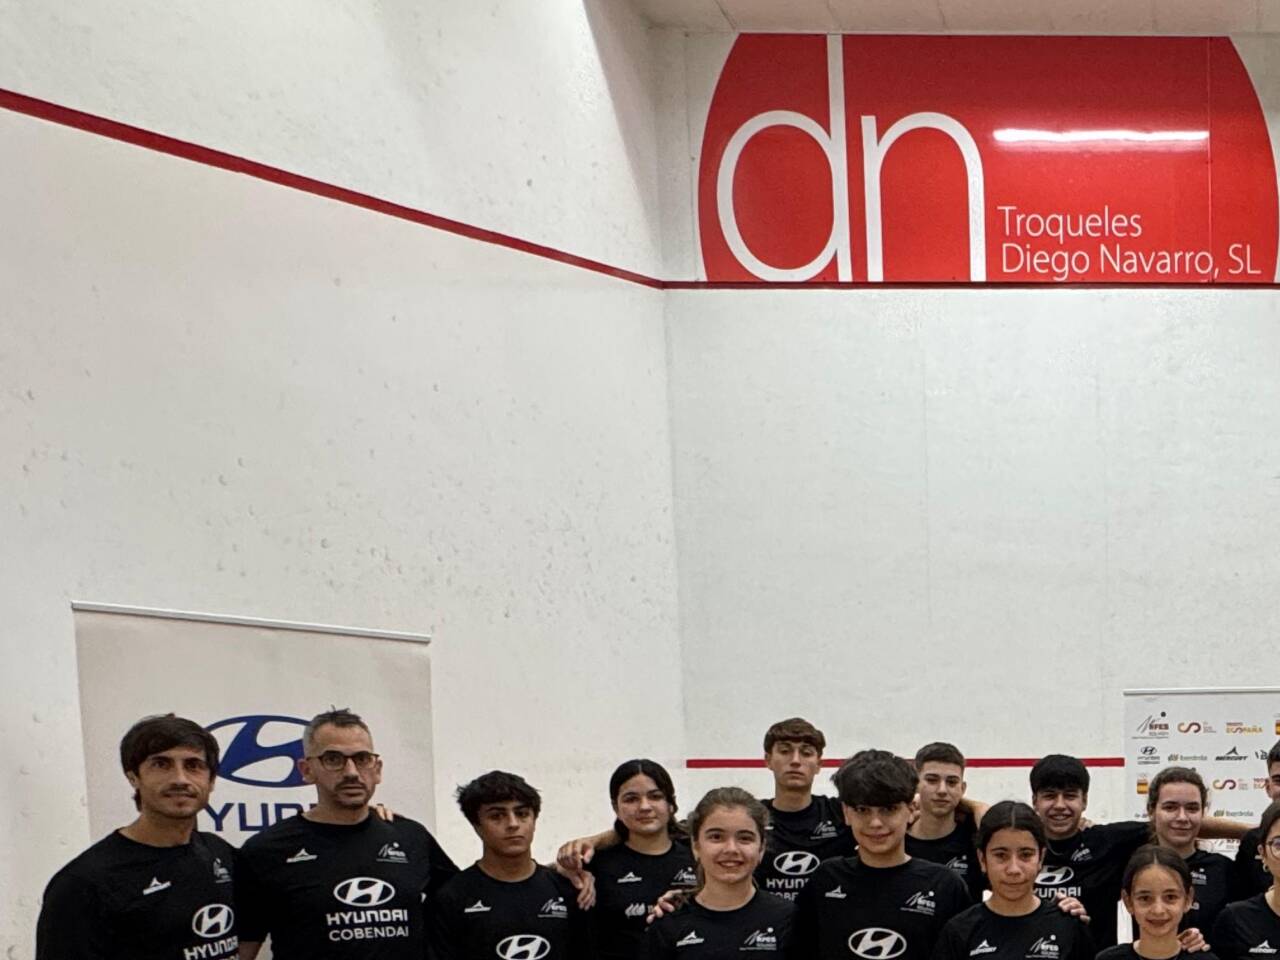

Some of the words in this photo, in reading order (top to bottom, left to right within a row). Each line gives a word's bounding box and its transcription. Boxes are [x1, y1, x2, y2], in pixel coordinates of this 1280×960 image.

[717, 33, 986, 282] dn
[997, 205, 1143, 244] Troqueles
[1002, 243, 1090, 282] Diego
[1100, 243, 1219, 278] Navarro,
[1228, 243, 1262, 274] SL
[766, 878, 809, 889] HYUN
[326, 909, 408, 926] HYUNDAI
[329, 926, 409, 942] COBENDAI
